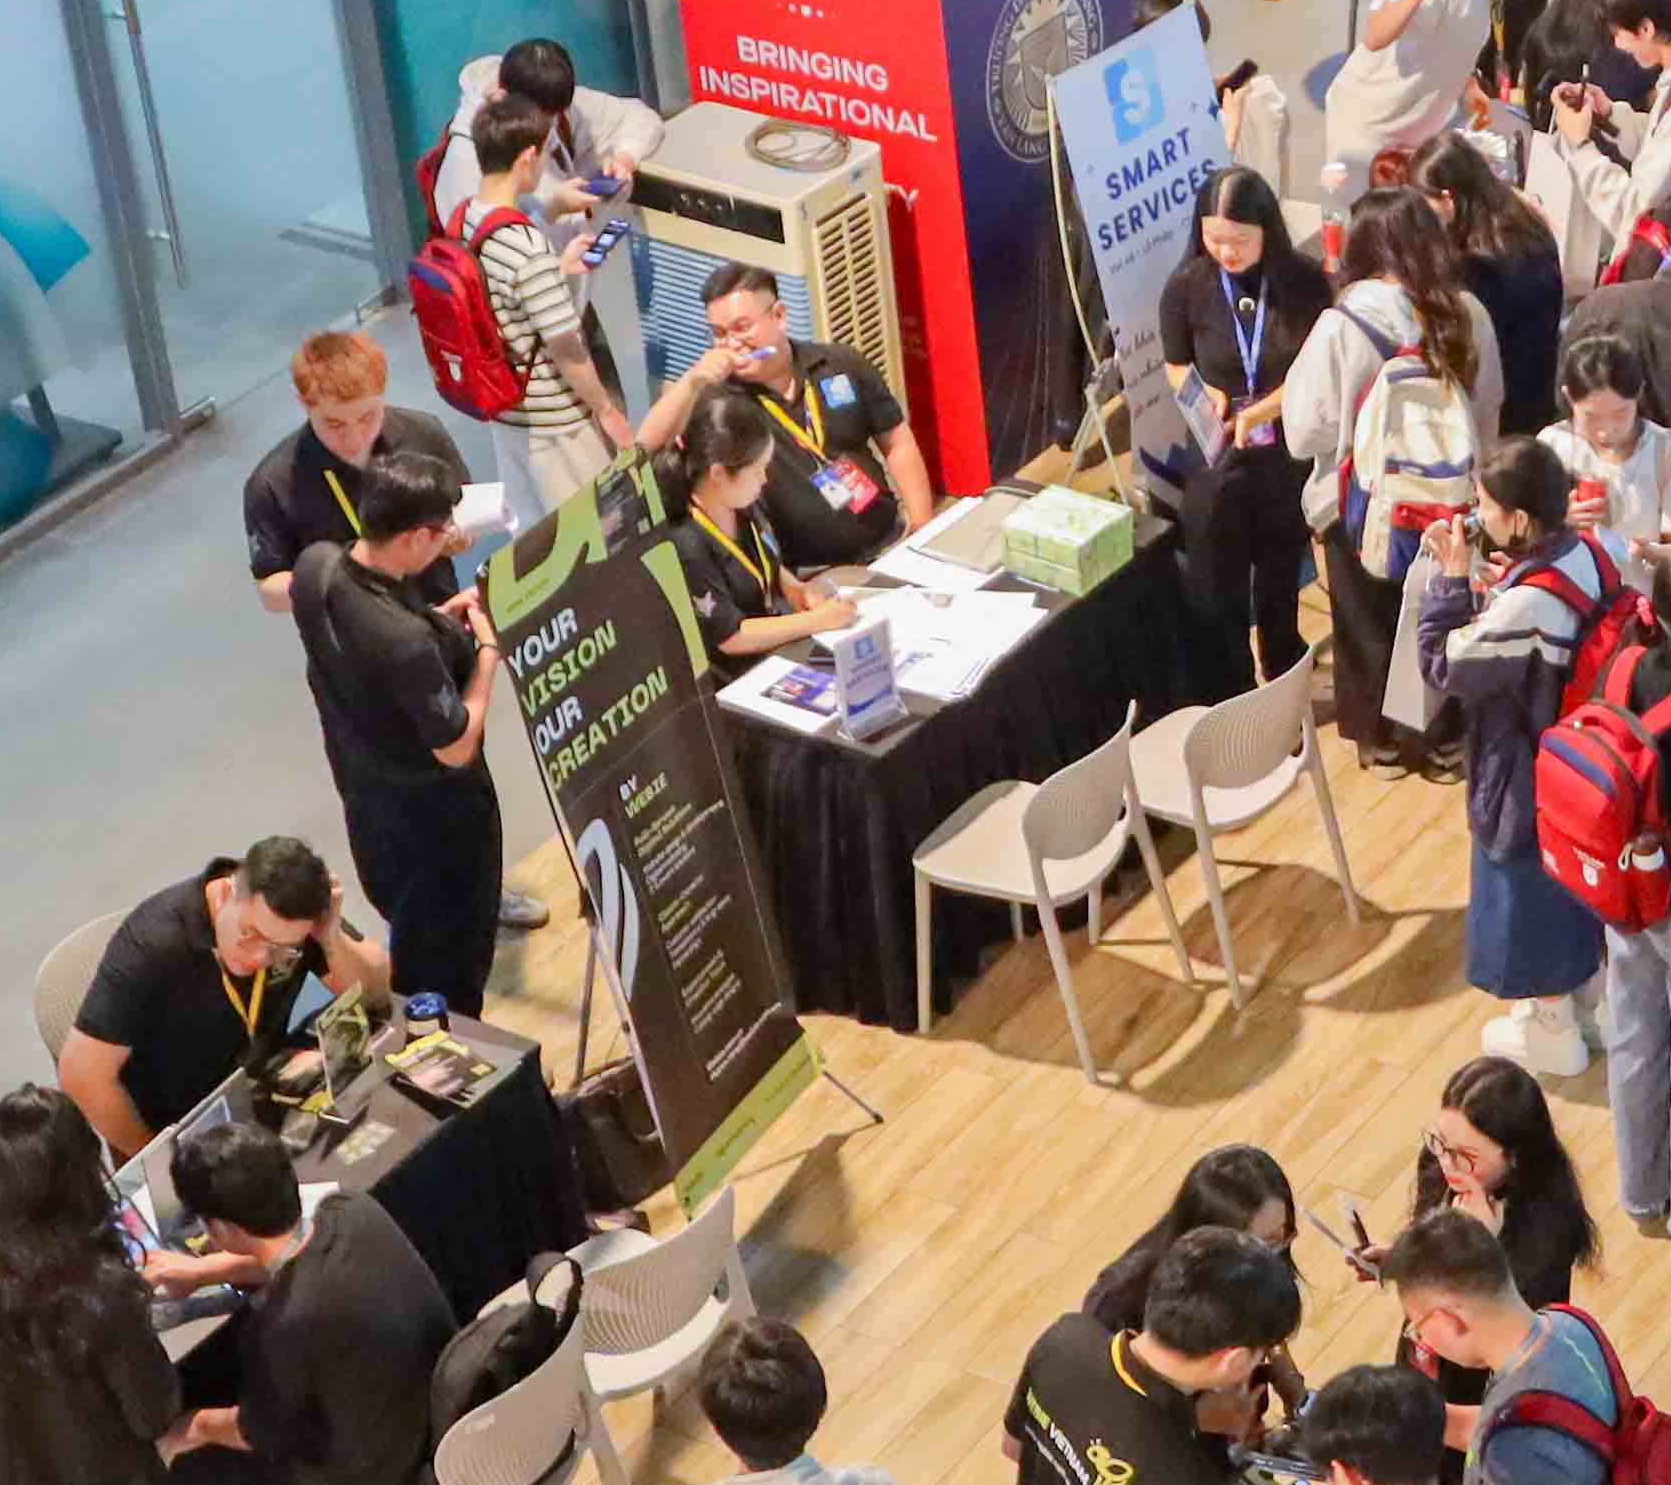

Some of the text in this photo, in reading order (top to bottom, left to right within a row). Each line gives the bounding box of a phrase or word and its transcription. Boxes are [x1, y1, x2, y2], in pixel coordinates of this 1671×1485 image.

[736, 35, 890, 93] BRINGING
[698, 65, 938, 142] INSPIRATIONAL
[1105, 127, 1193, 201] SMART
[1097, 158, 1217, 252] SERVICES
[507, 607, 578, 679] YOUR
[520, 619, 618, 719] VISION
[534, 695, 584, 755] OUR
[547, 666, 668, 790] CREATION
[619, 774, 638, 802] BY
